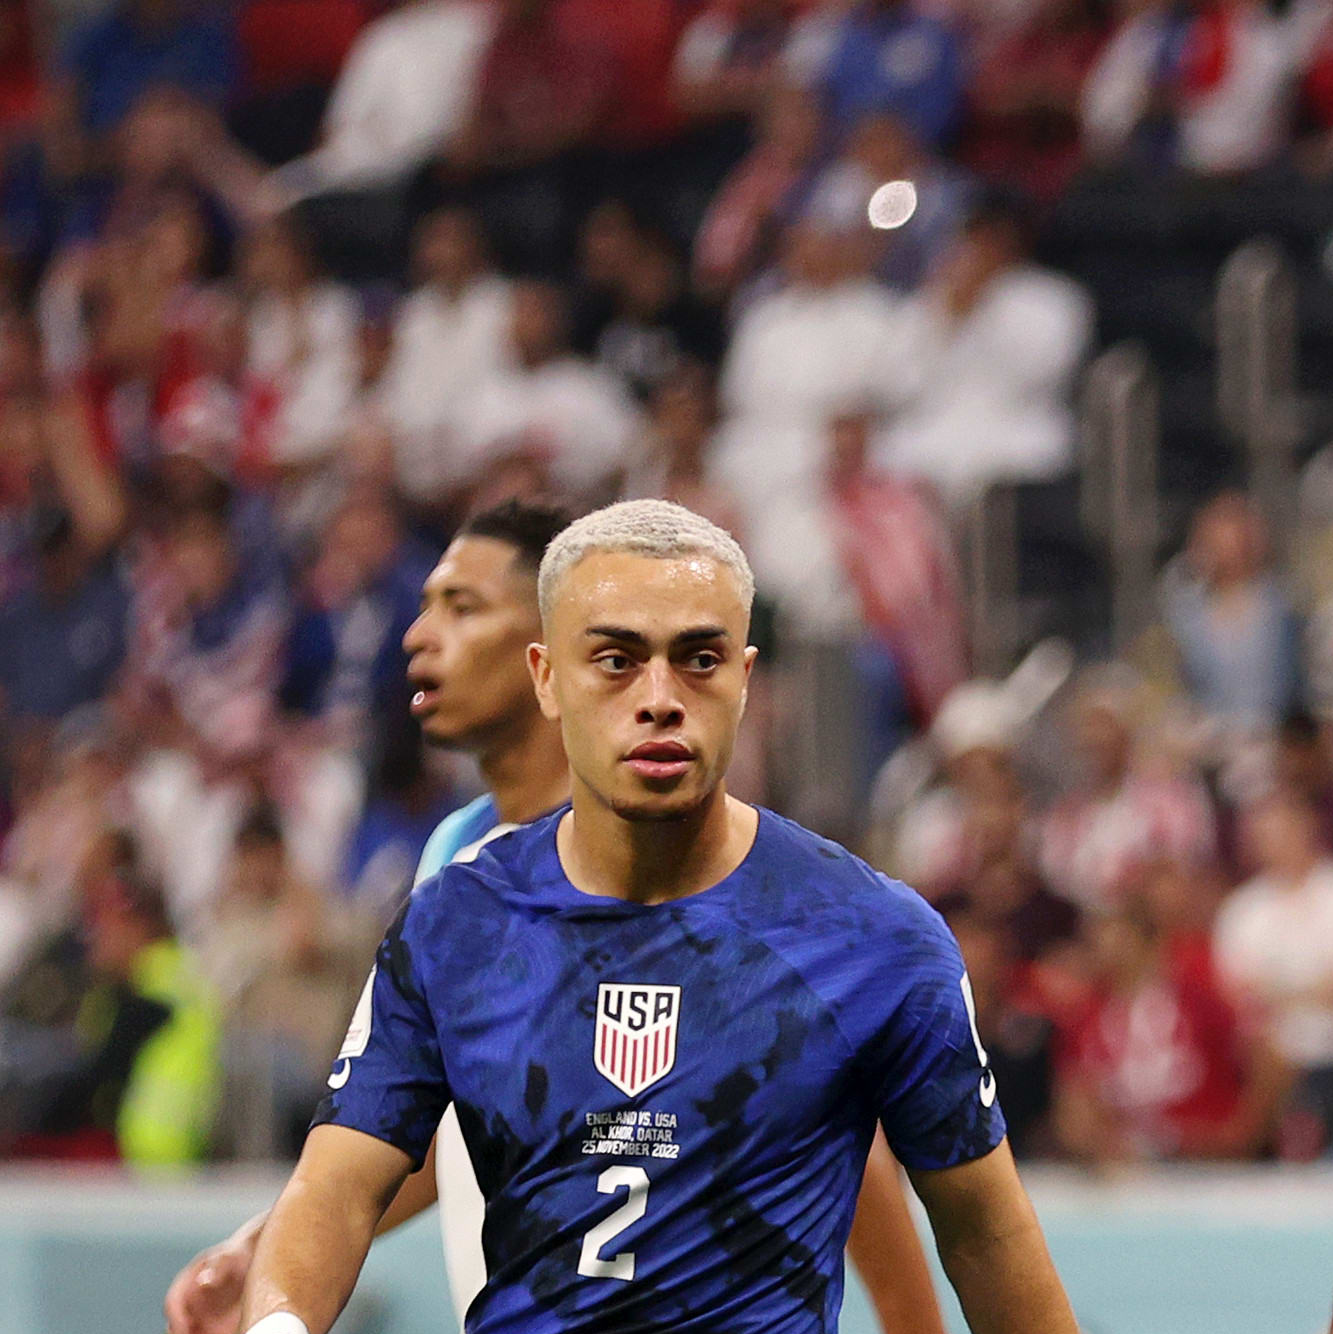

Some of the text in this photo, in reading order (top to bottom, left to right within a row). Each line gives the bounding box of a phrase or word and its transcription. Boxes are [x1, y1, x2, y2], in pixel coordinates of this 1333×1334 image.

[603, 990, 674, 1031] USA
[585, 1111, 637, 1127] ENGLAND
[654, 1112, 678, 1128] USA
[591, 1126, 607, 1139] AL
[636, 1128, 673, 1142] QATAR
[581, 1140, 596, 1154] 25
[651, 1143, 680, 1159] 2022
[577, 1165, 650, 1280] 2
